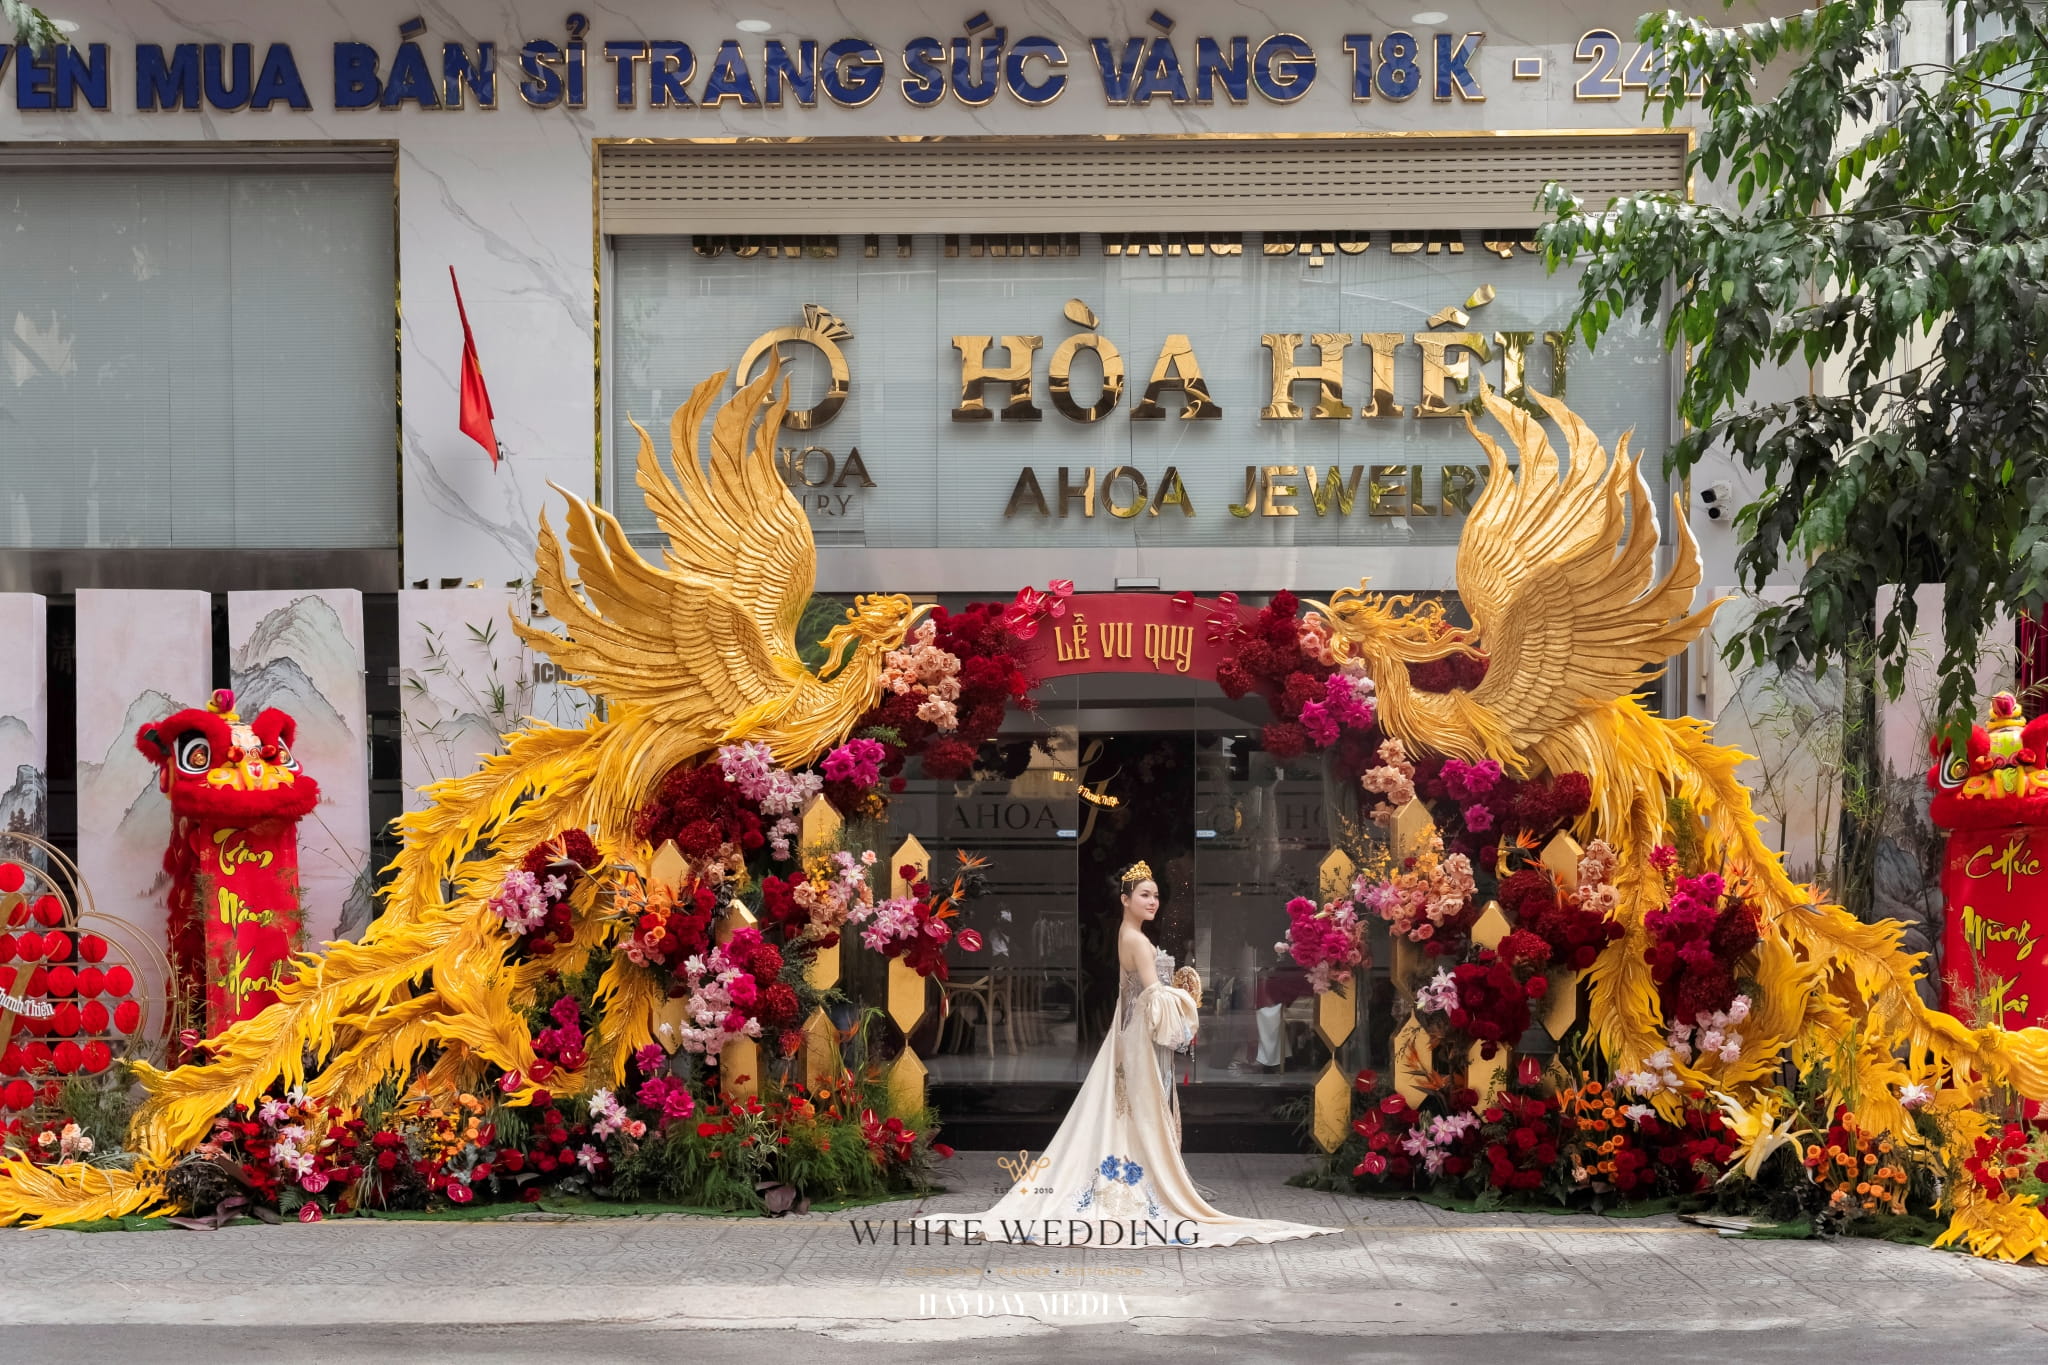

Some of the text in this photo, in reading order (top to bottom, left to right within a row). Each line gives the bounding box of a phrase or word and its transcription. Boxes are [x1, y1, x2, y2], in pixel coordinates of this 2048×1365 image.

[136, 42, 312, 112] MUA
[334, 15, 497, 111] BÁN
[519, 12, 590, 109] SỈ
[604, 38, 884, 109] TRANG
[902, 11, 1069, 108] SỨC
[1089, 10, 1318, 107] VÀNG
[952, 284, 1576, 422] HÒA HIẾU
[1004, 466, 1196, 518] AHOA
